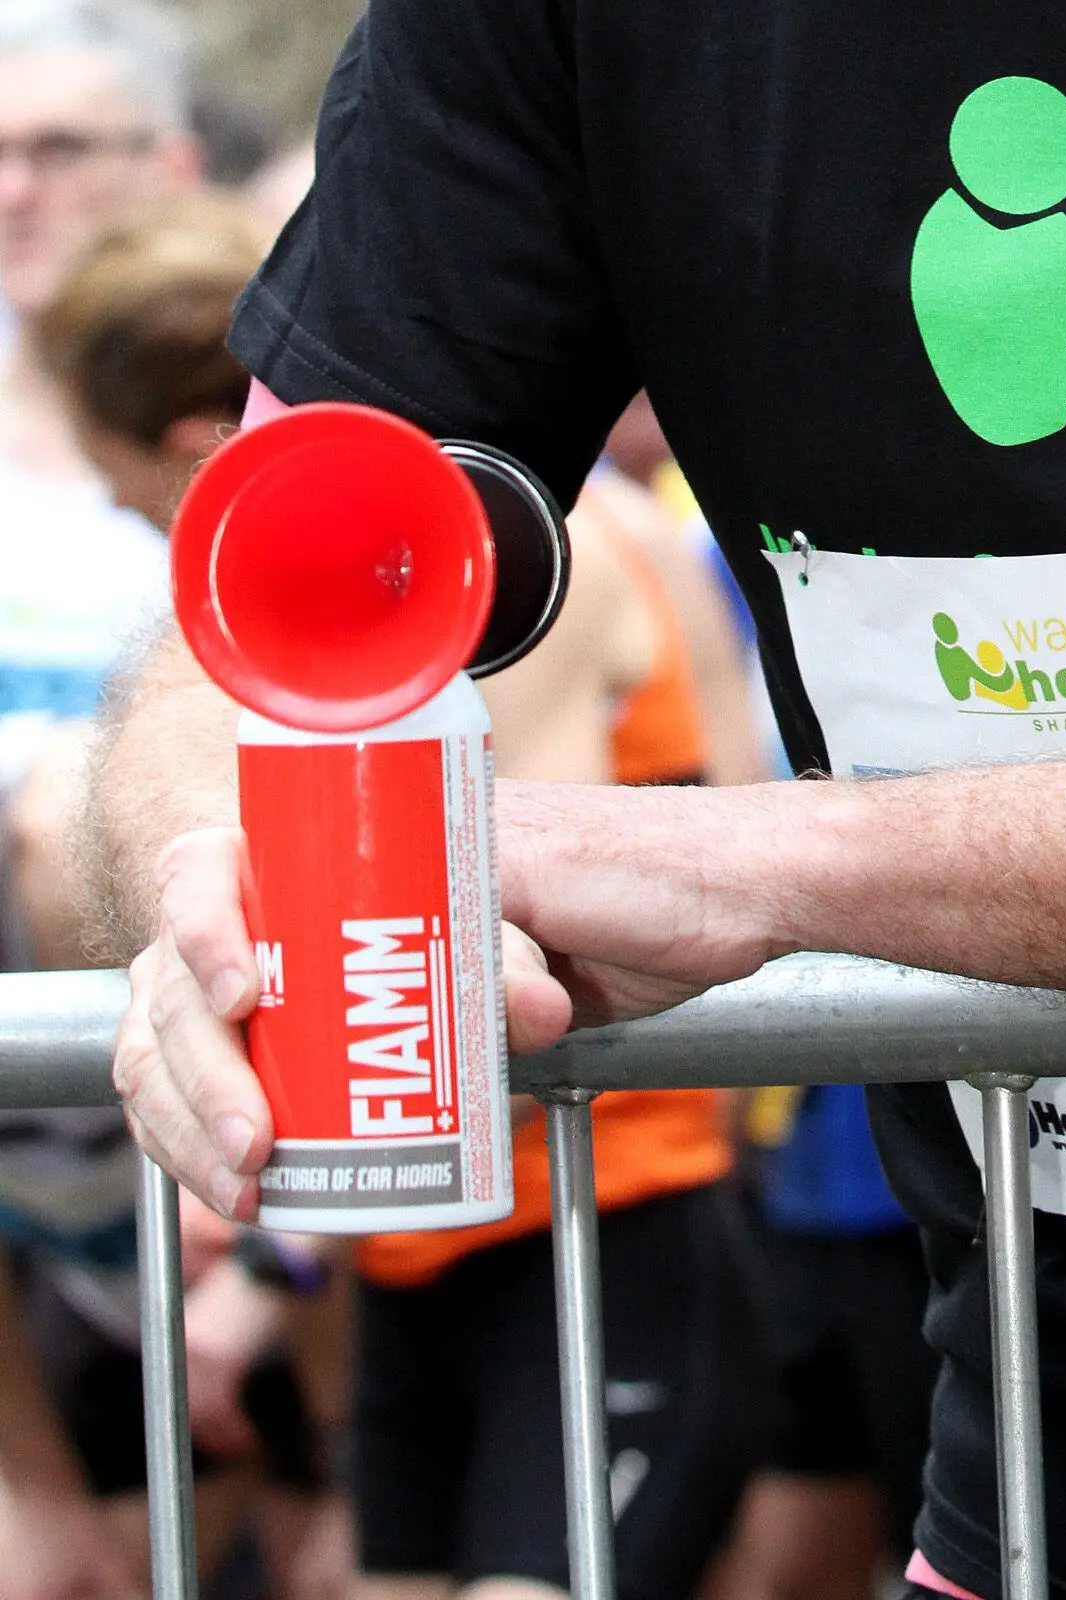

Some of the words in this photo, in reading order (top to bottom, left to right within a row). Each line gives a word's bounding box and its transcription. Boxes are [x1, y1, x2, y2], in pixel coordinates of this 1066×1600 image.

[341, 916, 434, 1137] FIAMM
[332, 1167, 354, 1192] OF
[357, 1165, 392, 1191] CAR
[396, 1162, 453, 1189] HORNS
